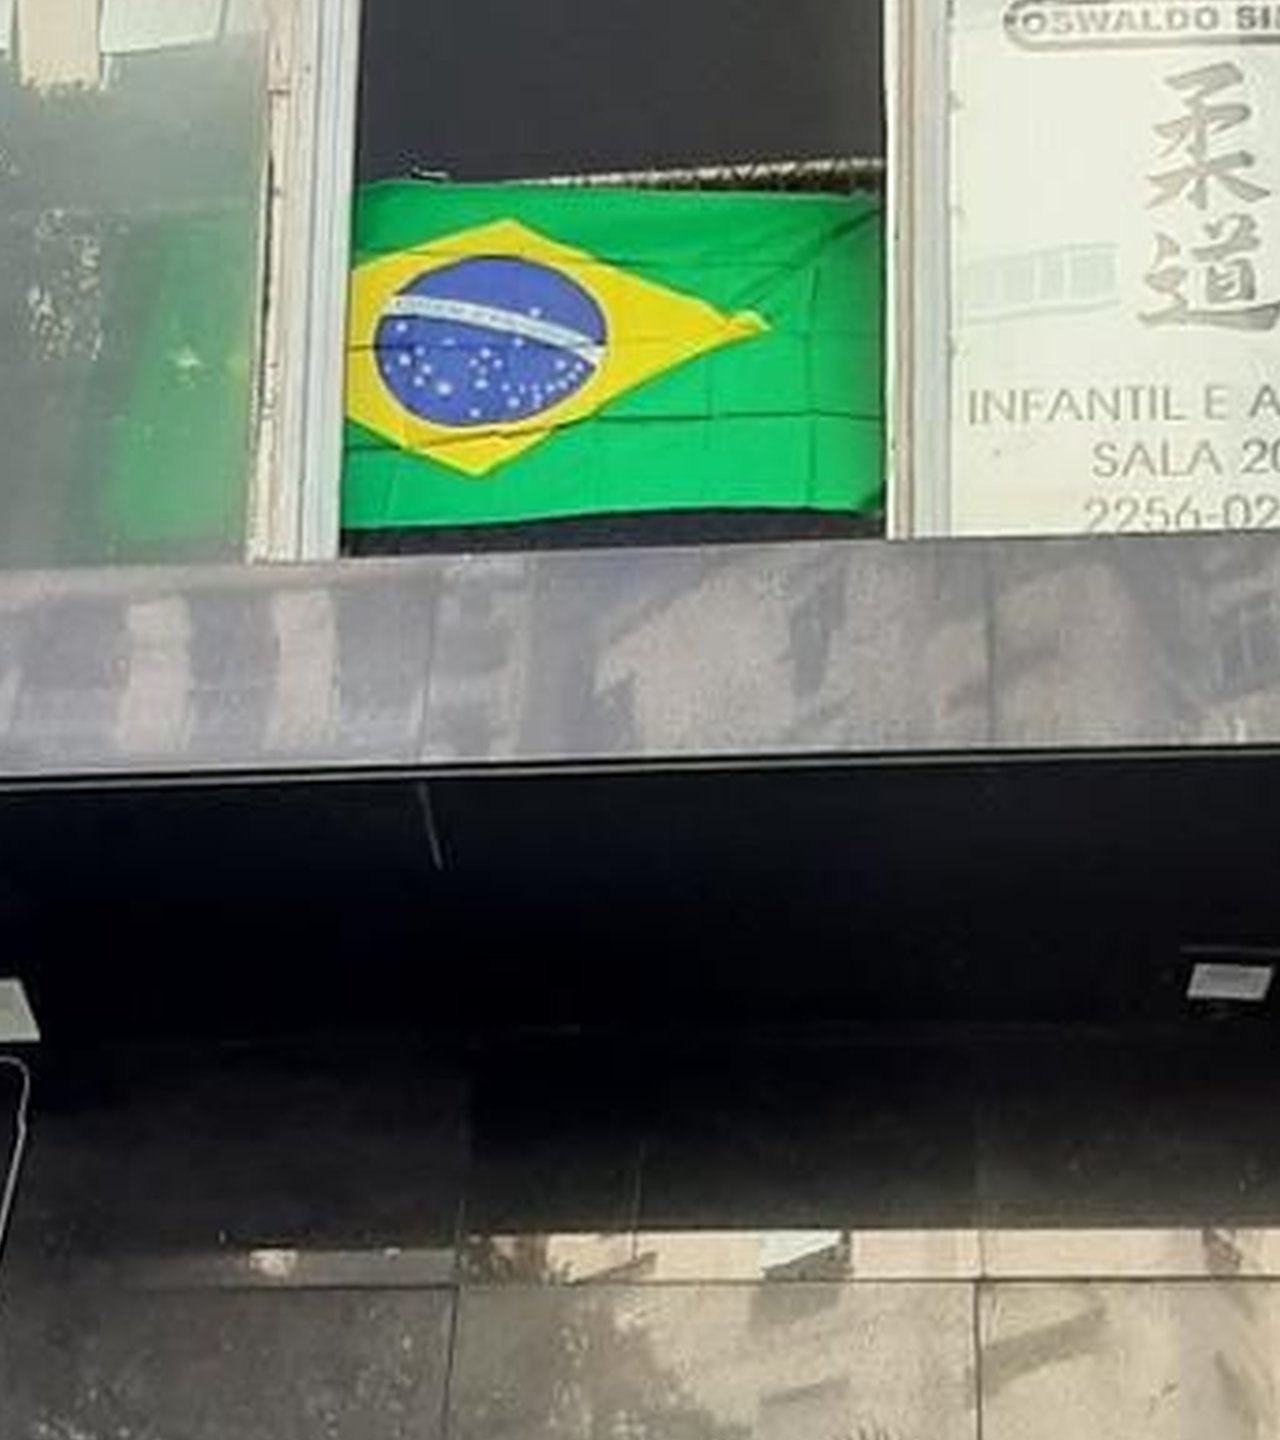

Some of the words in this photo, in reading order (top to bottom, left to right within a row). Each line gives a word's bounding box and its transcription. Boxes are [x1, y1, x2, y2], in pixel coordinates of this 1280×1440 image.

[1021, 5, 1220, 36] OSWALDO
[967, 385, 1185, 425] INFANTIL
[1204, 387, 1227, 420] E
[1091, 441, 1223, 478] SALA
